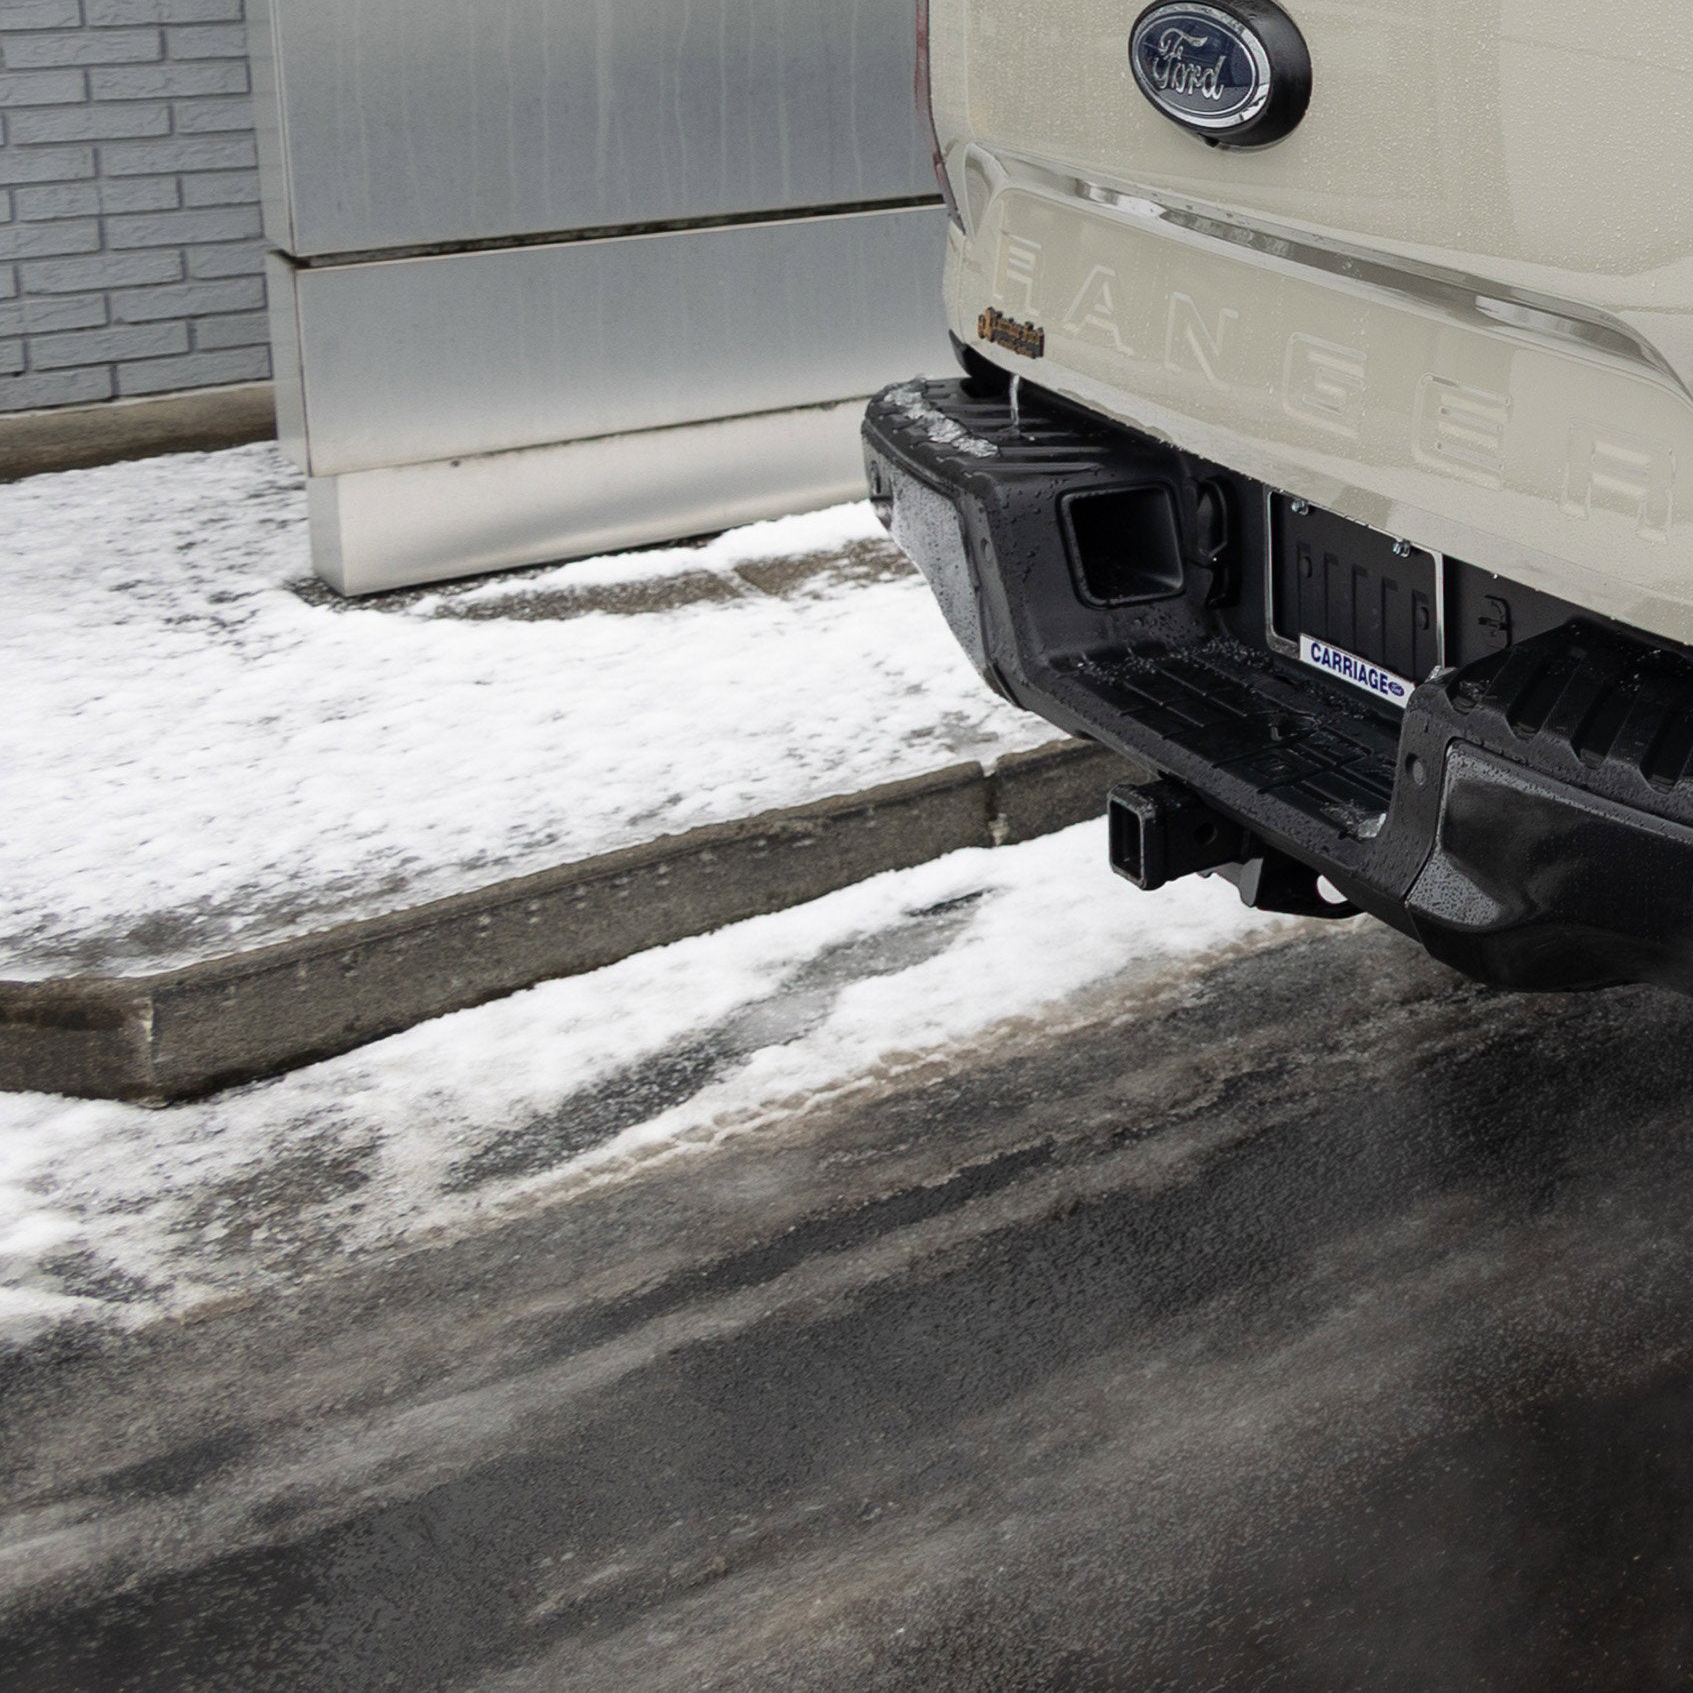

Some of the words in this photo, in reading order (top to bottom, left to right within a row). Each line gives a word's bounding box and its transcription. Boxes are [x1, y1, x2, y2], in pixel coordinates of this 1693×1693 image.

[1151, 25, 1226, 102] Ford
[992, 232, 1677, 545] RANGER
[1310, 642, 1389, 695] CARRIAGE
